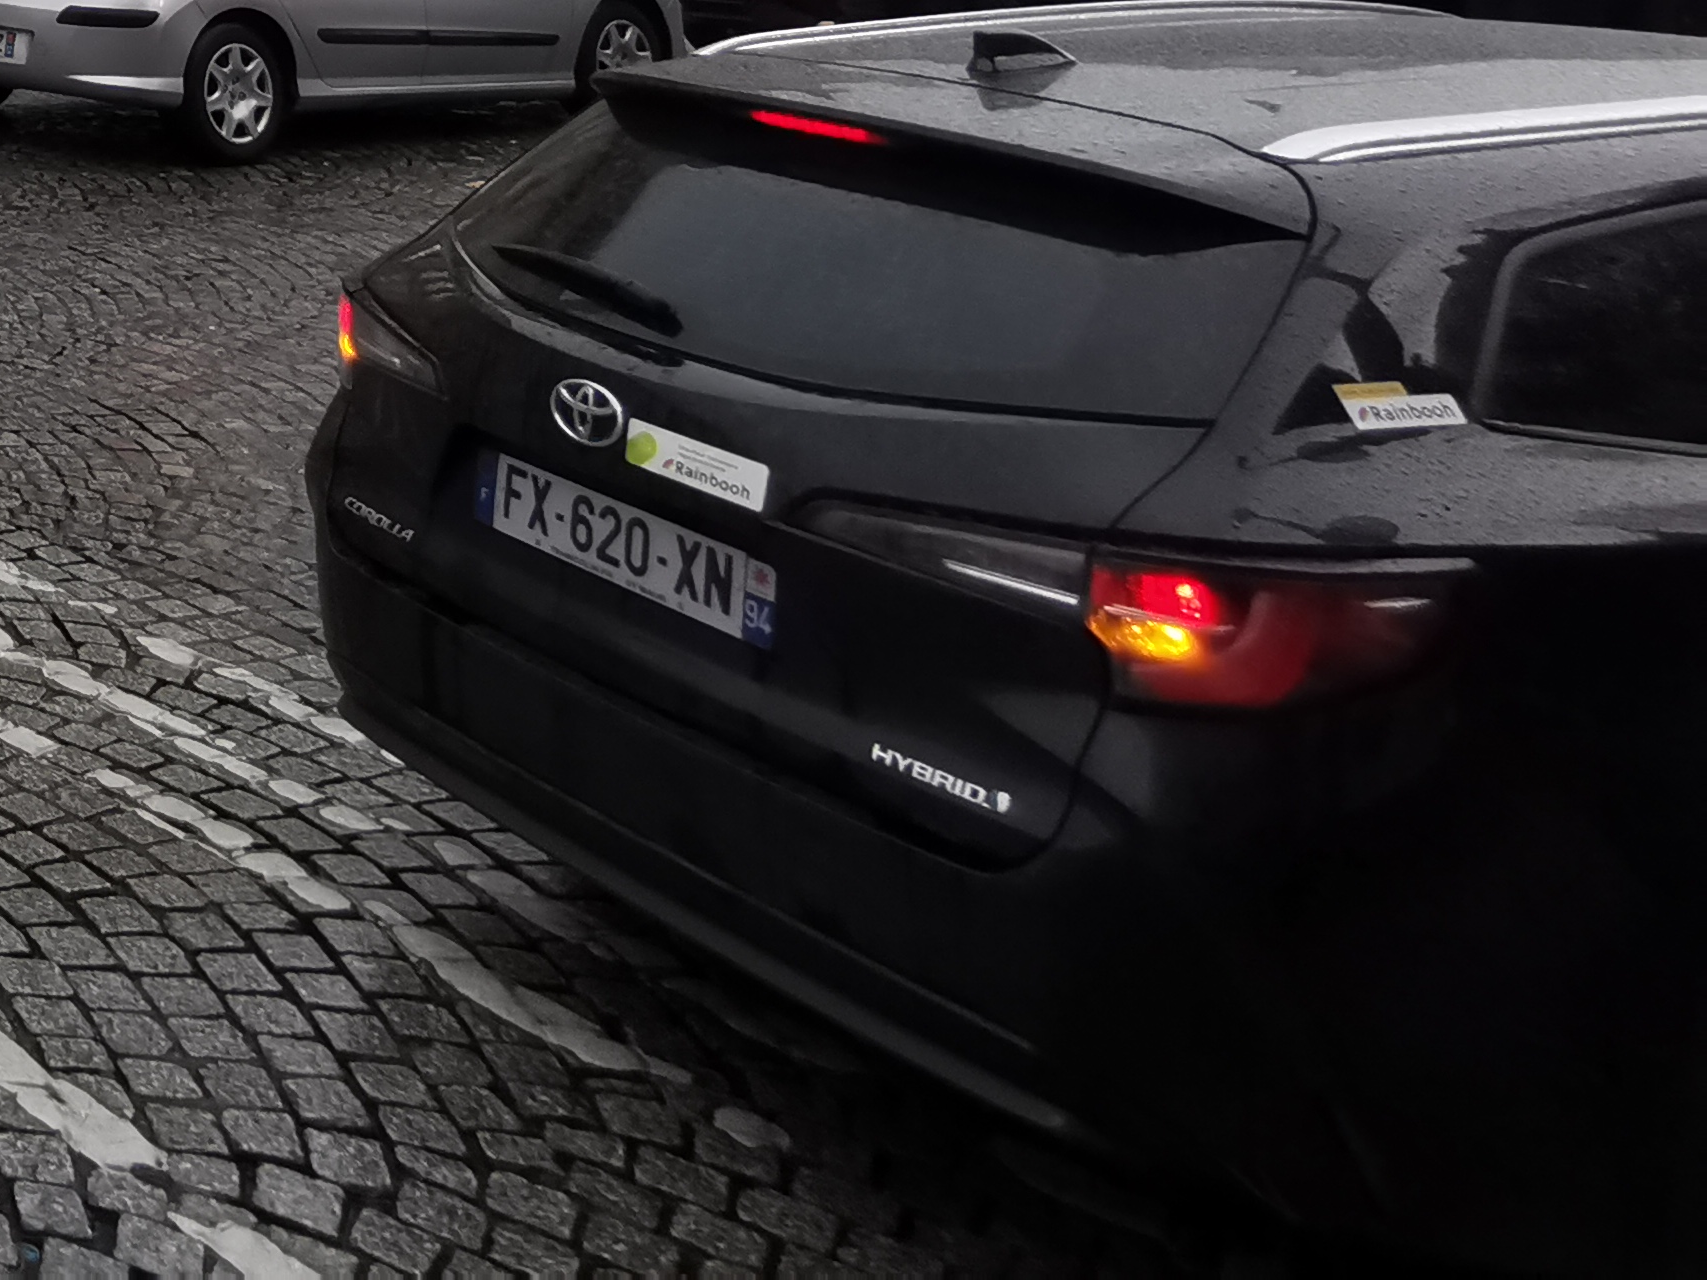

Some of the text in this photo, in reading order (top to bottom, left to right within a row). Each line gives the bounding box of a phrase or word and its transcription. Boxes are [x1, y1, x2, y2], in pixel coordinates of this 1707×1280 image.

[1367, 400, 1457, 423] Rainbooh
[674, 460, 751, 501] Rainbooh
[344, 496, 415, 543] COROLLA
[503, 462, 734, 617] FX-620-XN
[744, 599, 773, 635] 94
[871, 742, 988, 805] HYBRID
